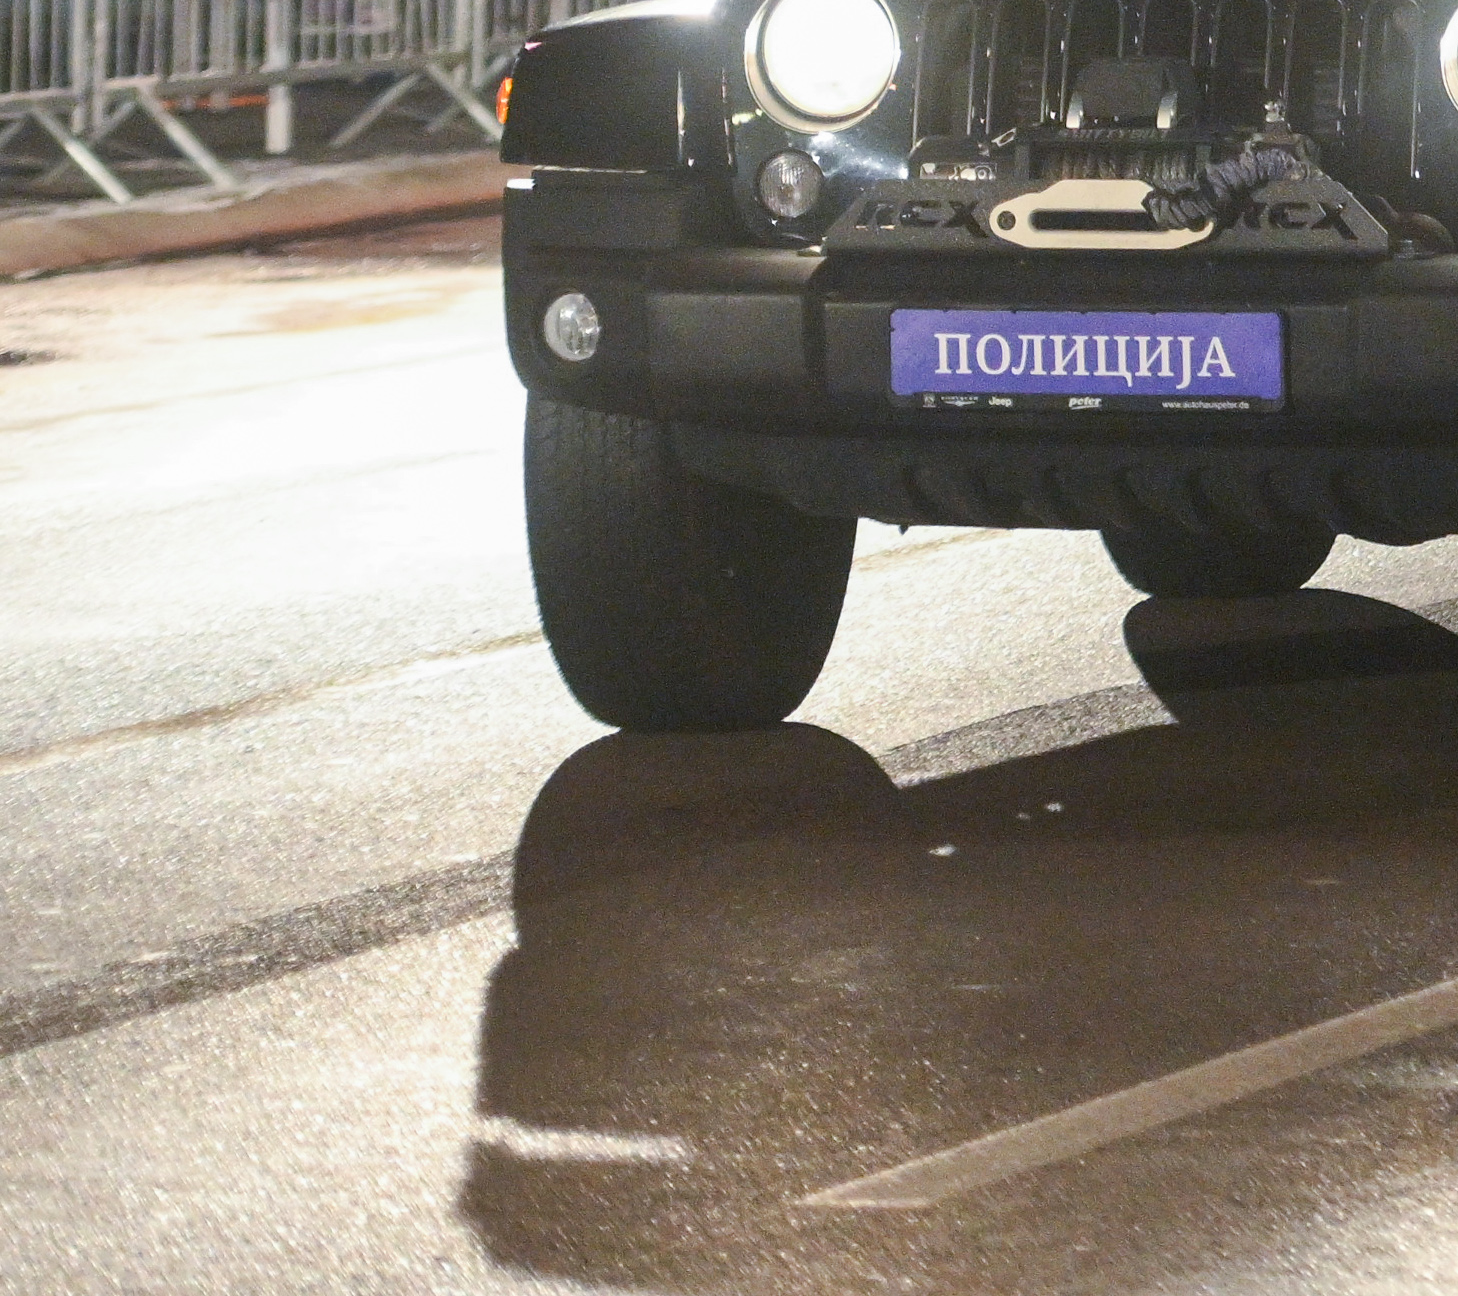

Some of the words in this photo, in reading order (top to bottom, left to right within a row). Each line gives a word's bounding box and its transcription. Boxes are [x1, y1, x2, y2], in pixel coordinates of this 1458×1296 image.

[934, 333, 1236, 388] ПОЛИЦИЈА
[988, 396, 1013, 407] Jeep
[1068, 397, 1102, 409] peter
